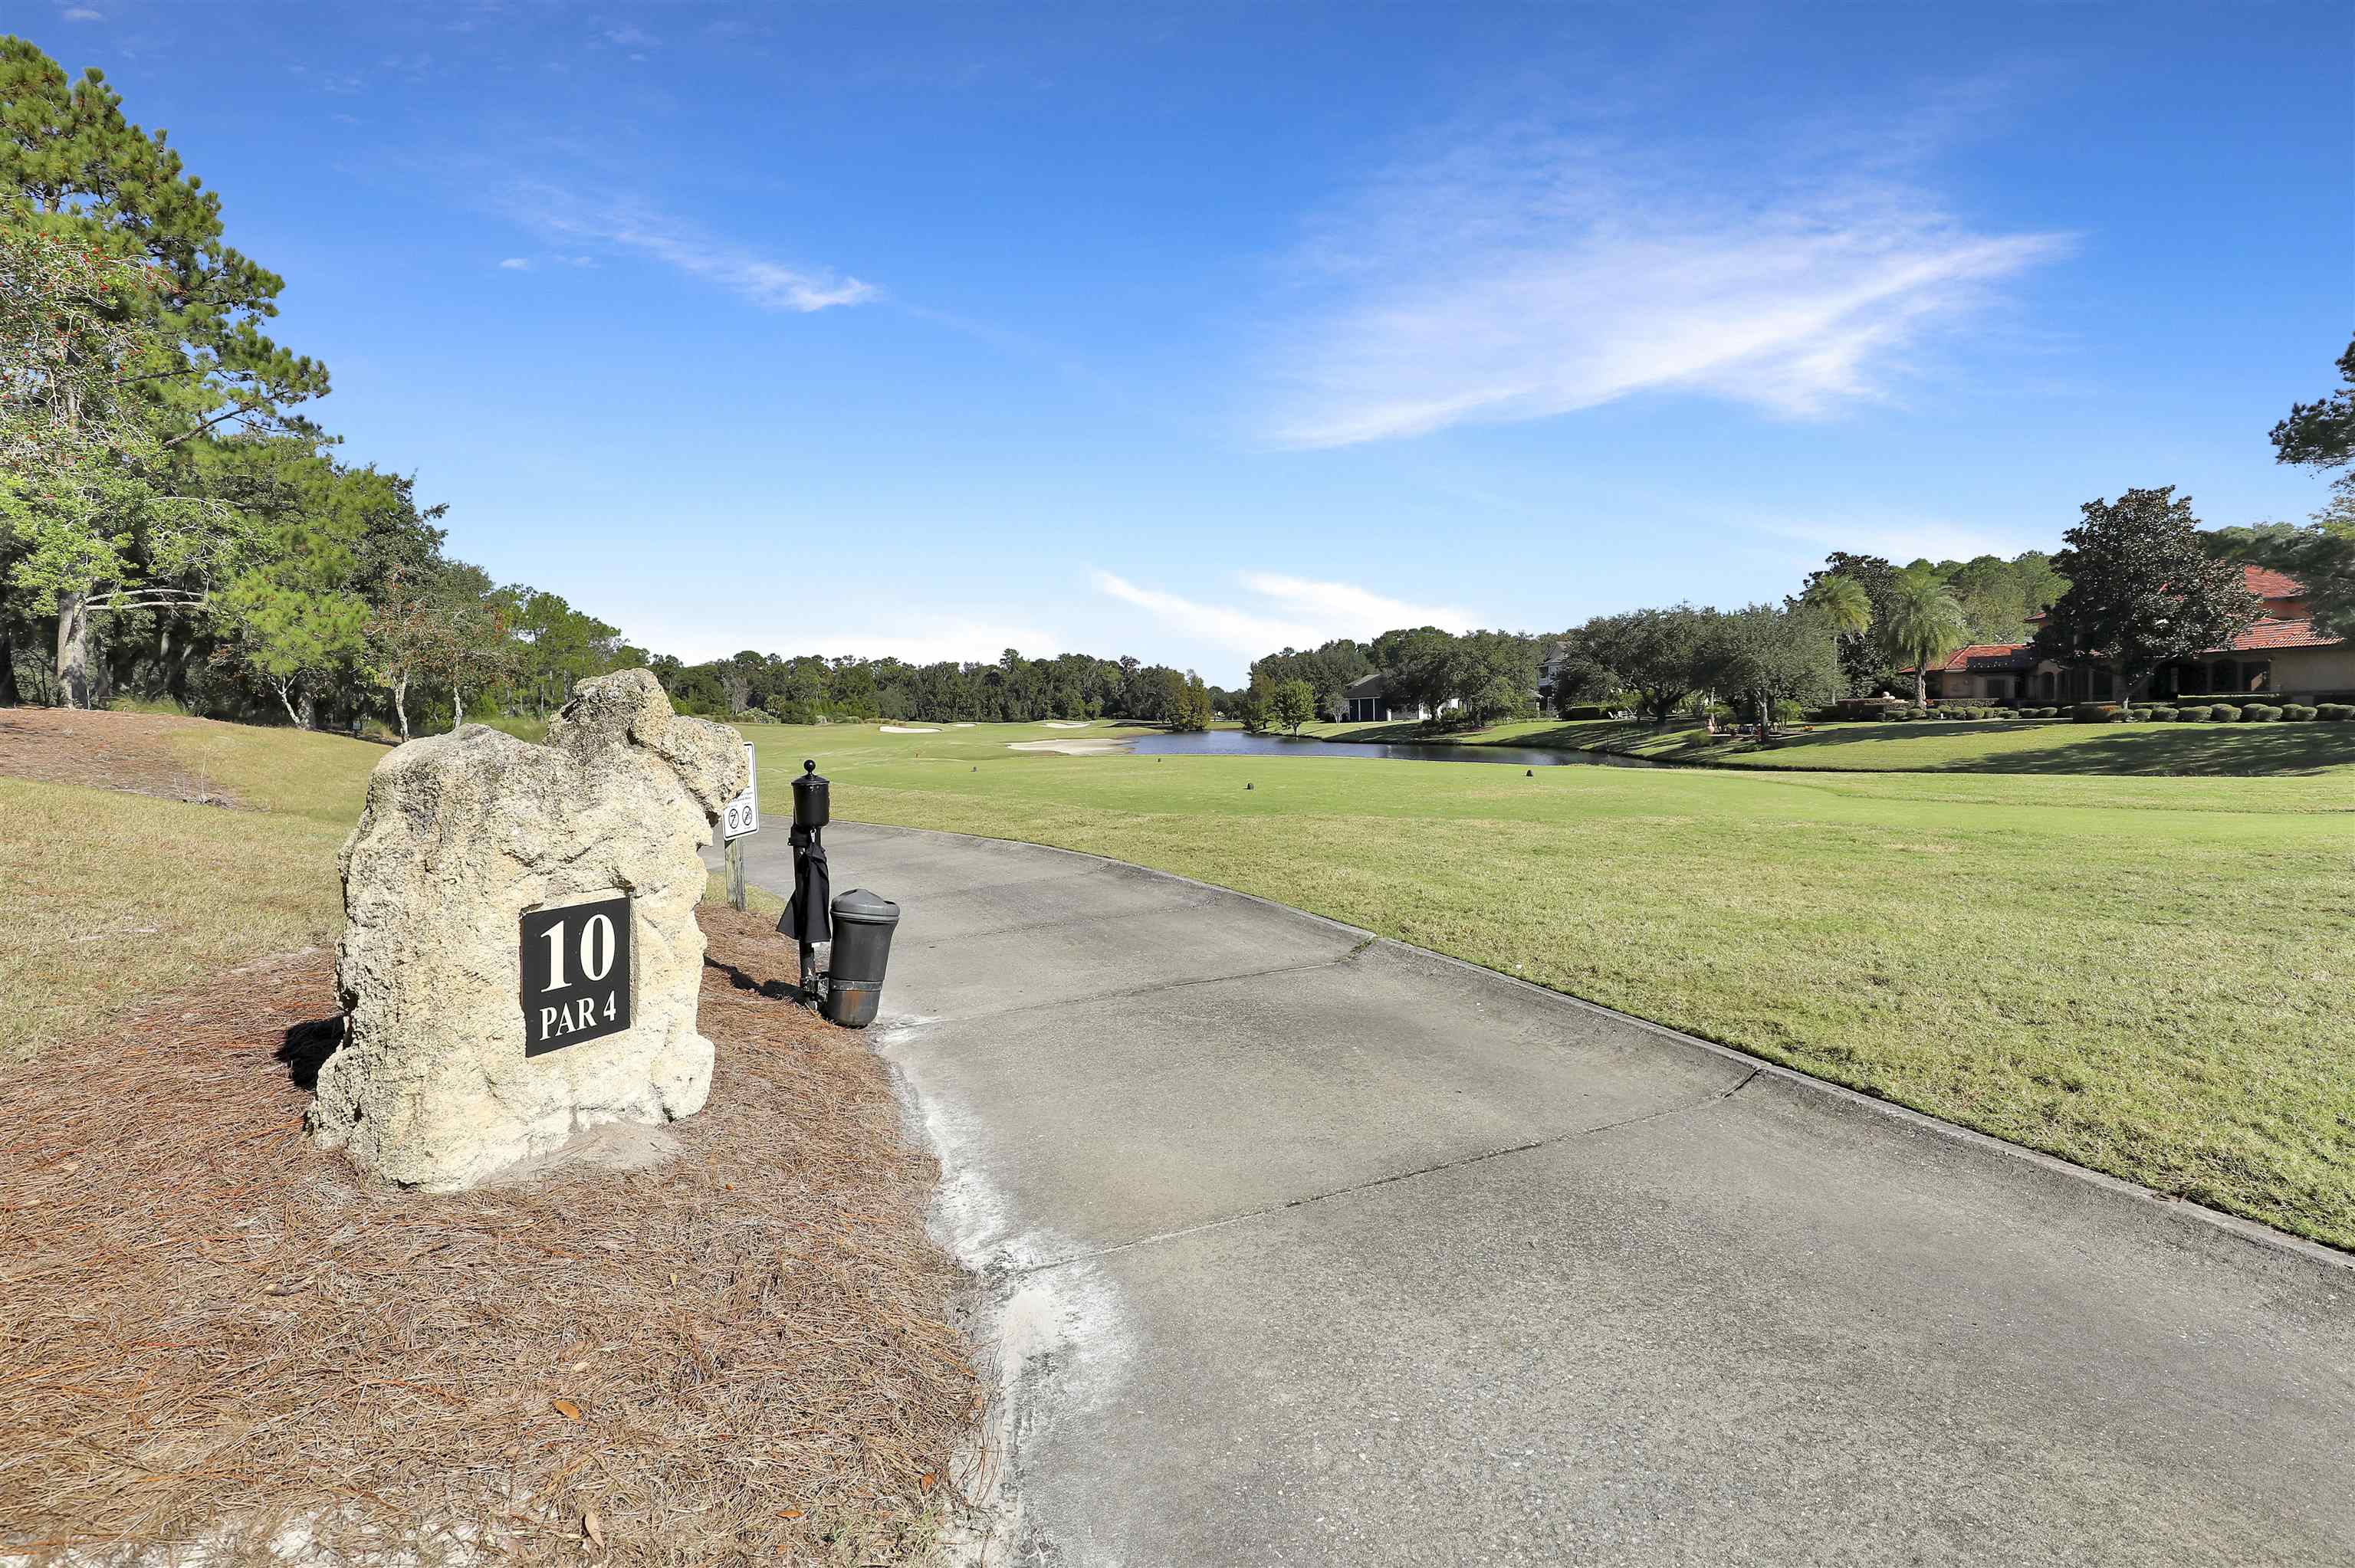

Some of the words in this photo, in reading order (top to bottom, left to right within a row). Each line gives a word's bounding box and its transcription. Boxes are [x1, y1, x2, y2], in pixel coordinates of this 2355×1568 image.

[540, 914, 616, 993] 10
[539, 997, 597, 1041] PAR
[603, 990, 617, 1022] 4
